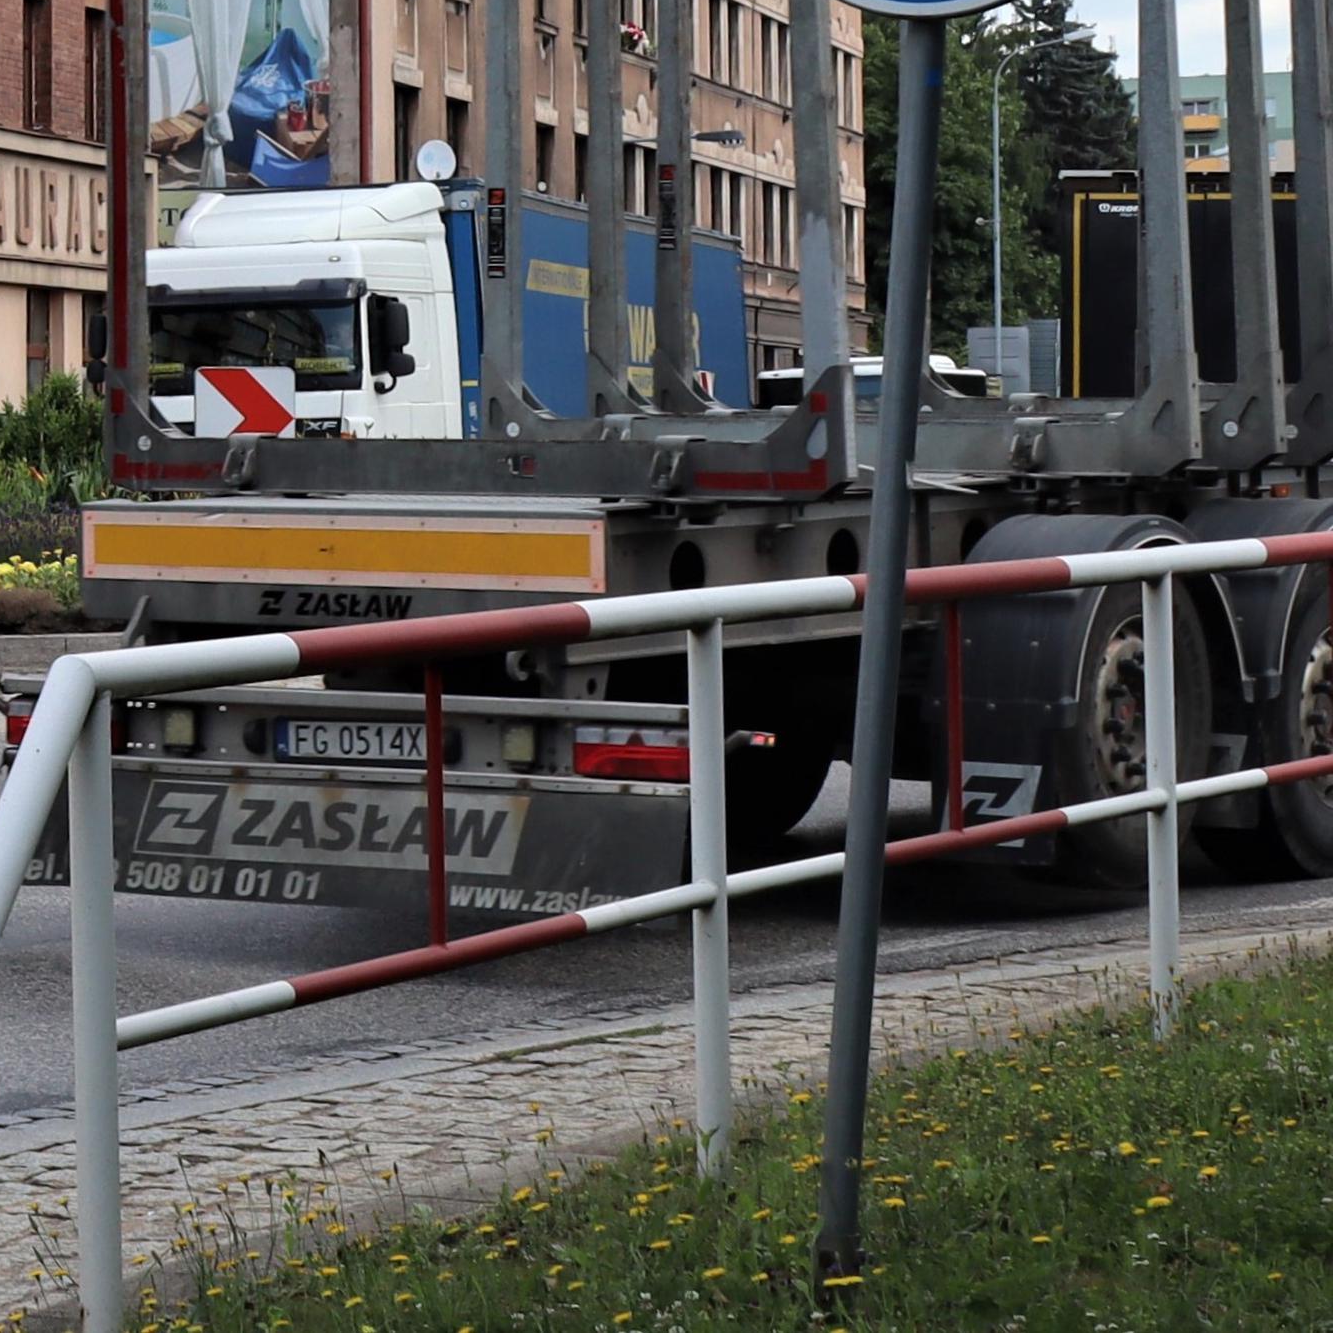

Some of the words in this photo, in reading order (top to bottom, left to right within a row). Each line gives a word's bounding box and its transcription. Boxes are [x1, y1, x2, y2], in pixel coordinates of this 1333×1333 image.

[306, 420, 338, 431] XF
[295, 592, 413, 618] ZASŁAW
[294, 724, 329, 755] FG
[339, 725, 423, 757] 0514X
[231, 799, 510, 859] ZASŁAW
[126, 860, 182, 892] 508
[188, 865, 225, 895] 01
[234, 867, 273, 898] 01
[282, 870, 322, 901] 01
